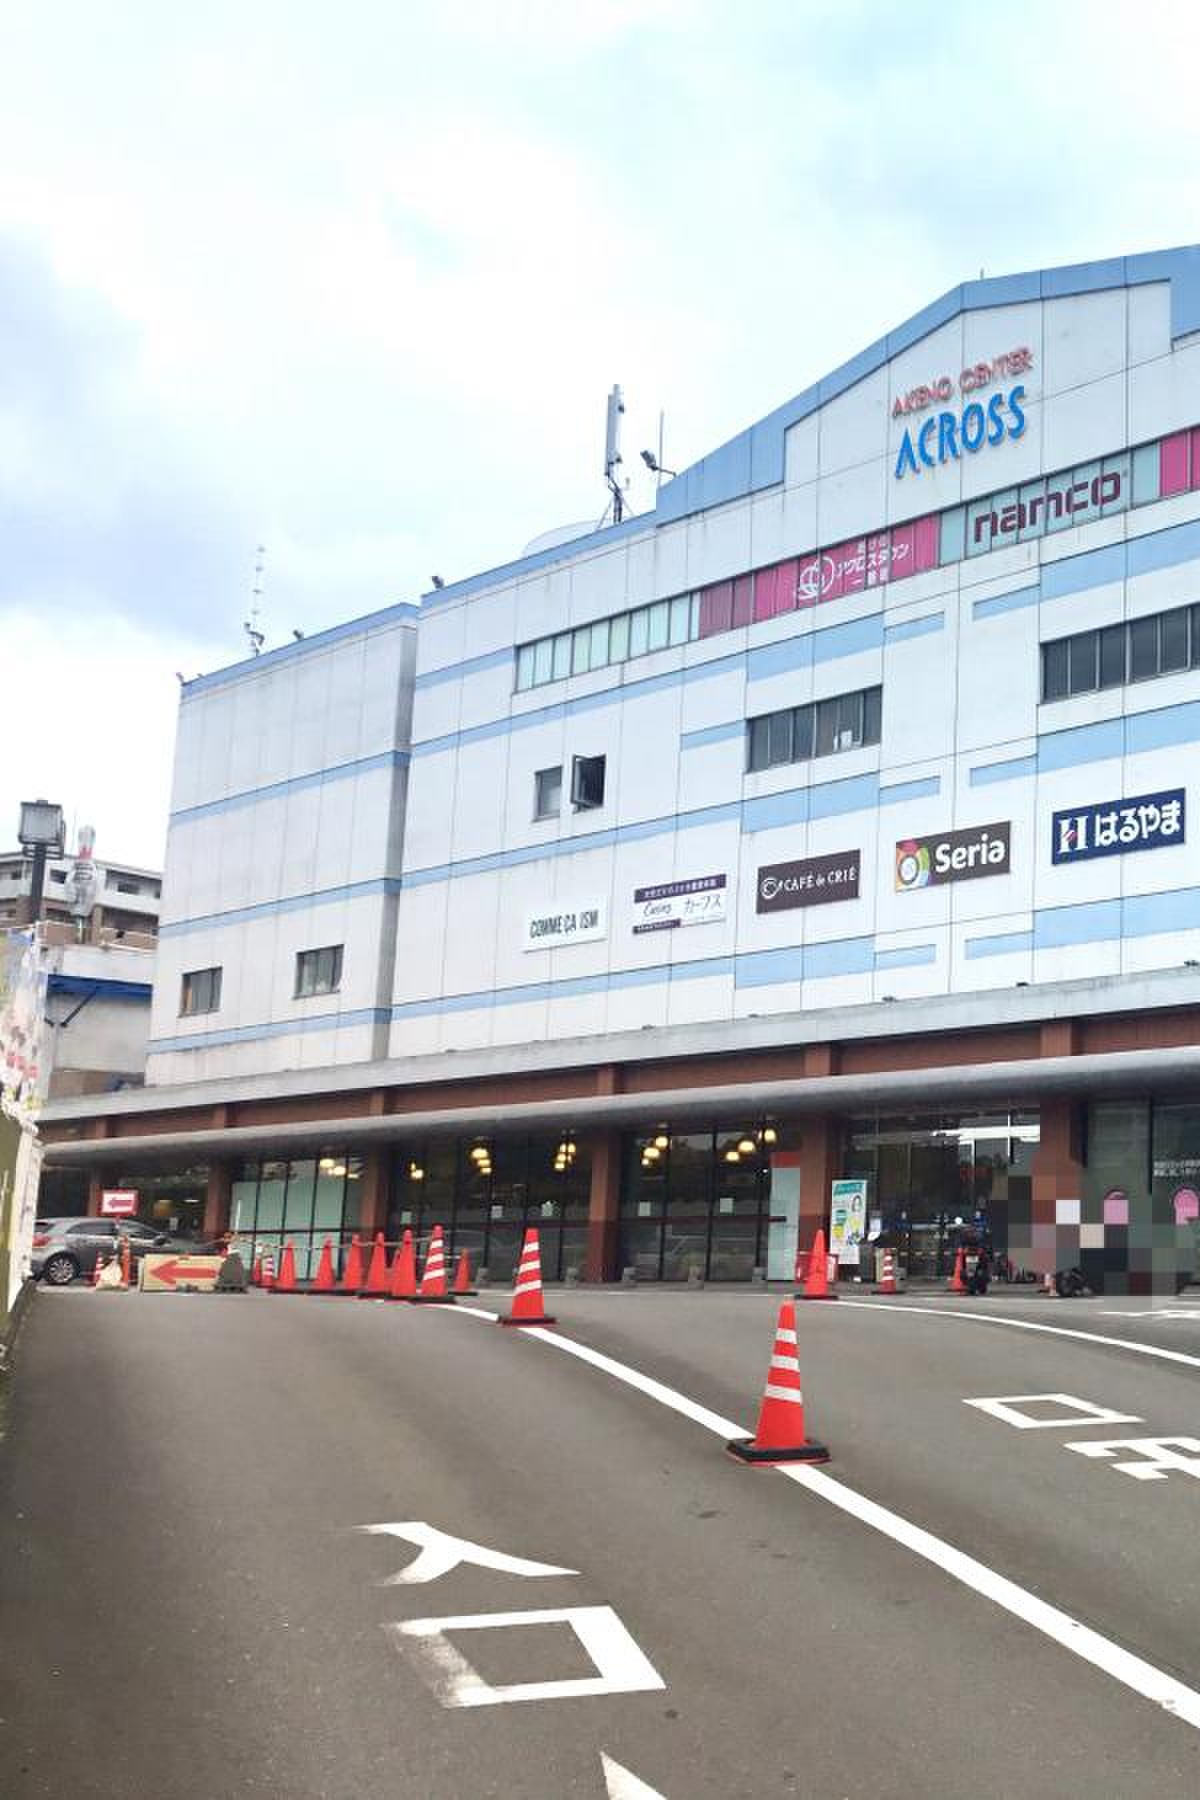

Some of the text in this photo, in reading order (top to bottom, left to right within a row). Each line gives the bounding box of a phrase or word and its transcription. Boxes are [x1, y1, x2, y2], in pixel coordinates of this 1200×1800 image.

[960, 347, 1033, 393] CENTER
[895, 385, 1027, 480] ACROSS
[974, 471, 1121, 543] namco
[935, 833, 1005, 873] Seria
[1094, 800, 1181, 847] はるやま
[351, 1520, 668, 1708] 入口
